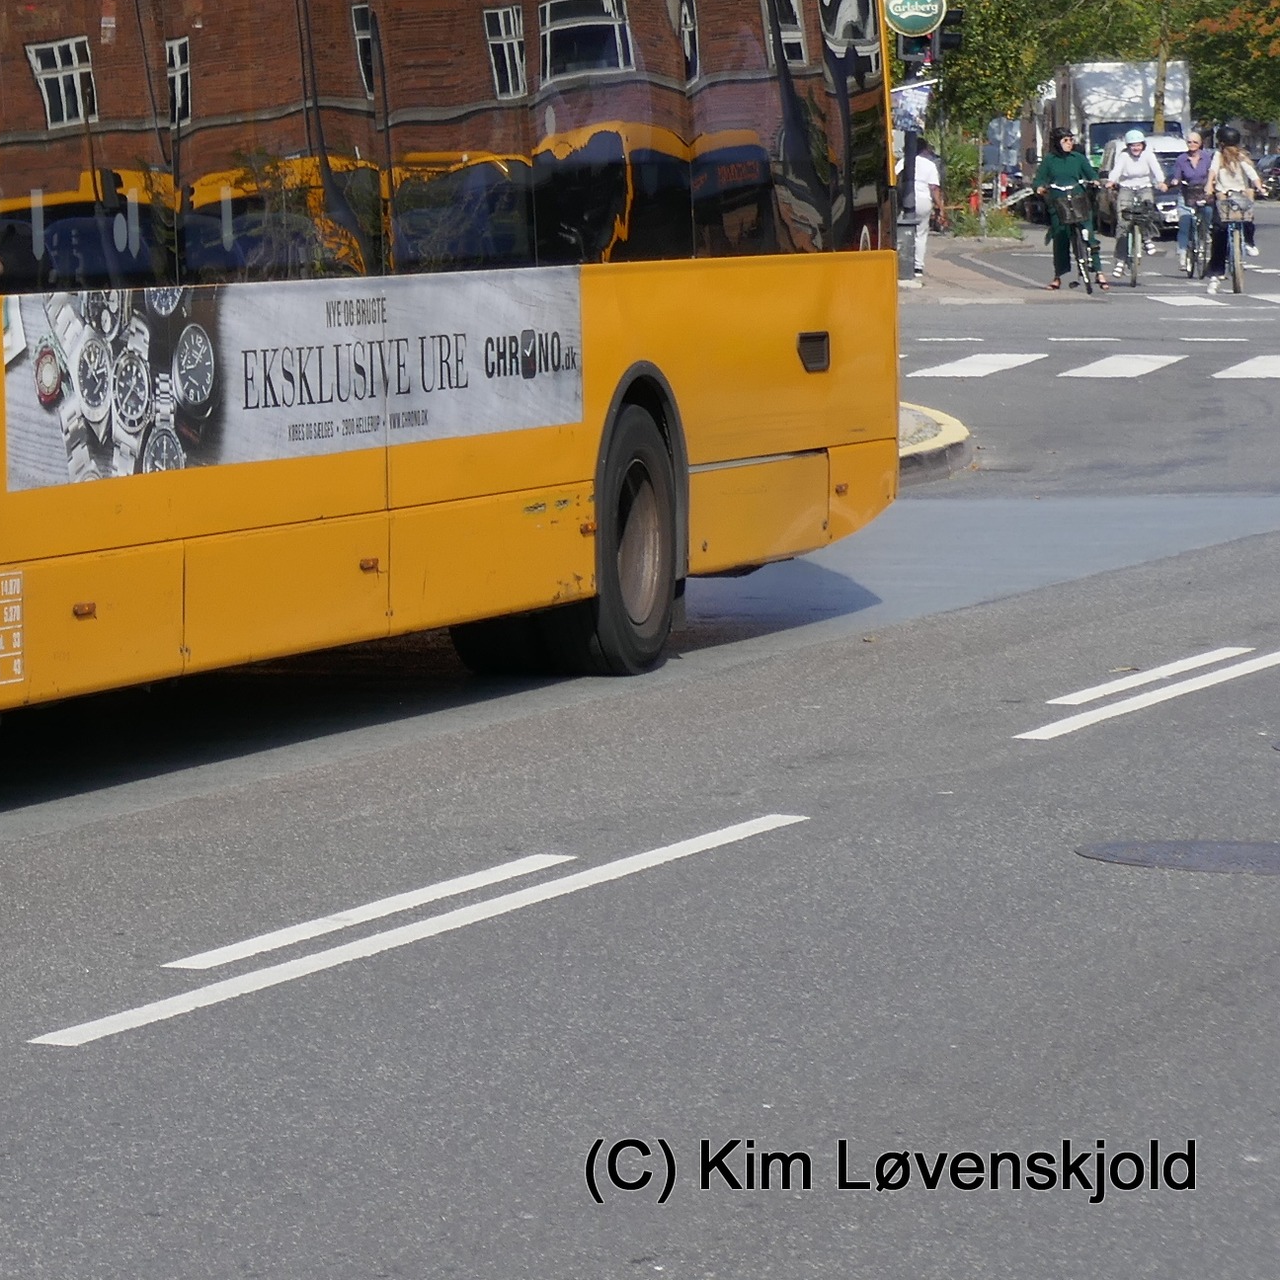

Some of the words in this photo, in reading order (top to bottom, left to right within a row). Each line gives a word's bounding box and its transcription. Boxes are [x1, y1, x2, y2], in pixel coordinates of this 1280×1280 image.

[326, 300, 342, 328] NYE
[343, 299, 355, 326] OG
[356, 297, 388, 324] BRUGTE
[241, 336, 412, 411] EKSKLUSIVE
[418, 332, 469, 392] URE
